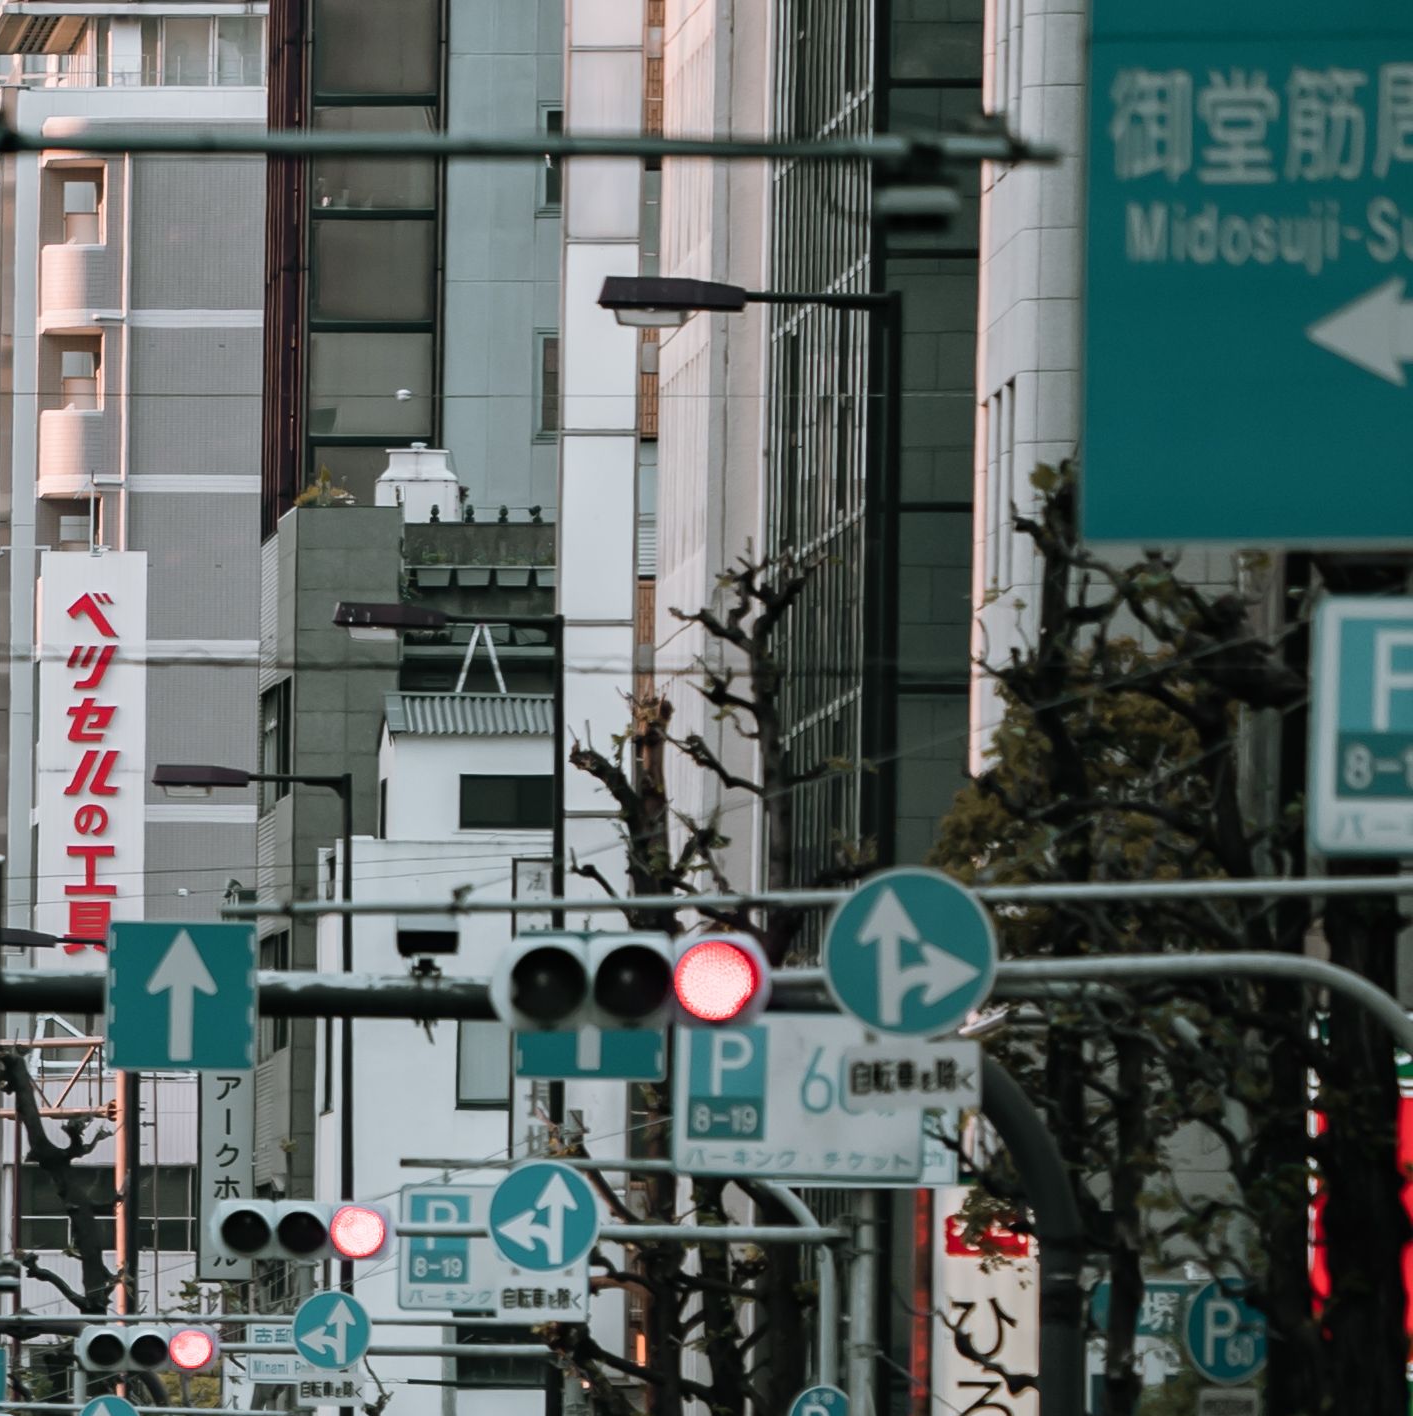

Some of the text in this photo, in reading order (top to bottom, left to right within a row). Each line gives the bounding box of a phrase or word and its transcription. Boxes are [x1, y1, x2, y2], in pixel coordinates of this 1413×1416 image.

[710, 1032, 754, 1097] P
[850, 1059, 975, 1095] 自転車を除く
[690, 1107, 759, 1133] 8-19
[215, 1075, 242, 1267] アークホル
[1204, 1301, 1240, 1367] P
[300, 1380, 363, 1400] 自転車を除く
